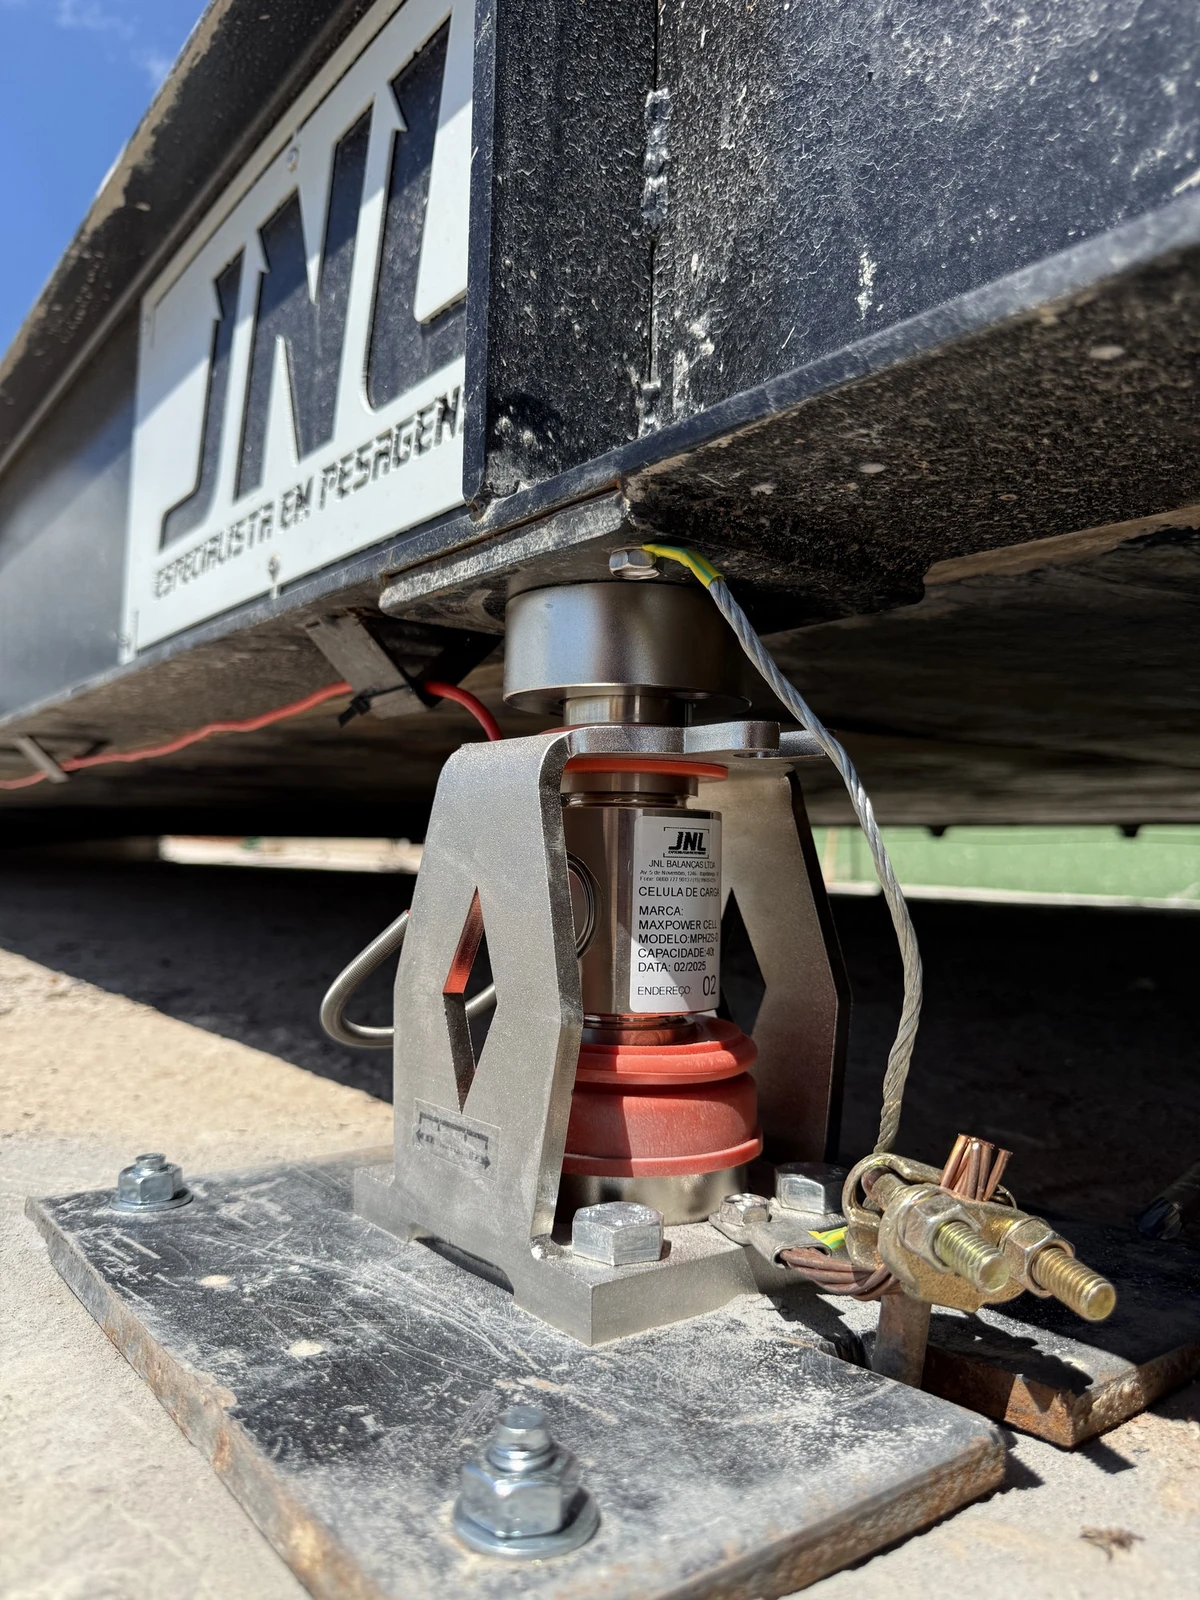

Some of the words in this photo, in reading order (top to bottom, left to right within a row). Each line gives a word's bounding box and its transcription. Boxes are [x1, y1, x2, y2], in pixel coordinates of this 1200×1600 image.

[159, 13, 466, 553] JNL
[153, 500, 274, 598] ESPECIALISTA
[279, 474, 315, 532] EM
[668, 831, 706, 851] JNL
[648, 860, 664, 868] JNL
[666, 860, 704, 870] BALANÇAS
[638, 886, 684, 897] CELULA
[685, 887, 698, 897] DE
[639, 905, 684, 916] MARCA:
[638, 920, 701, 930] MAXPOWER
[638, 962, 671, 972] DATA:
[673, 961, 707, 972] 02/2025
[702, 974, 717, 996] 02
